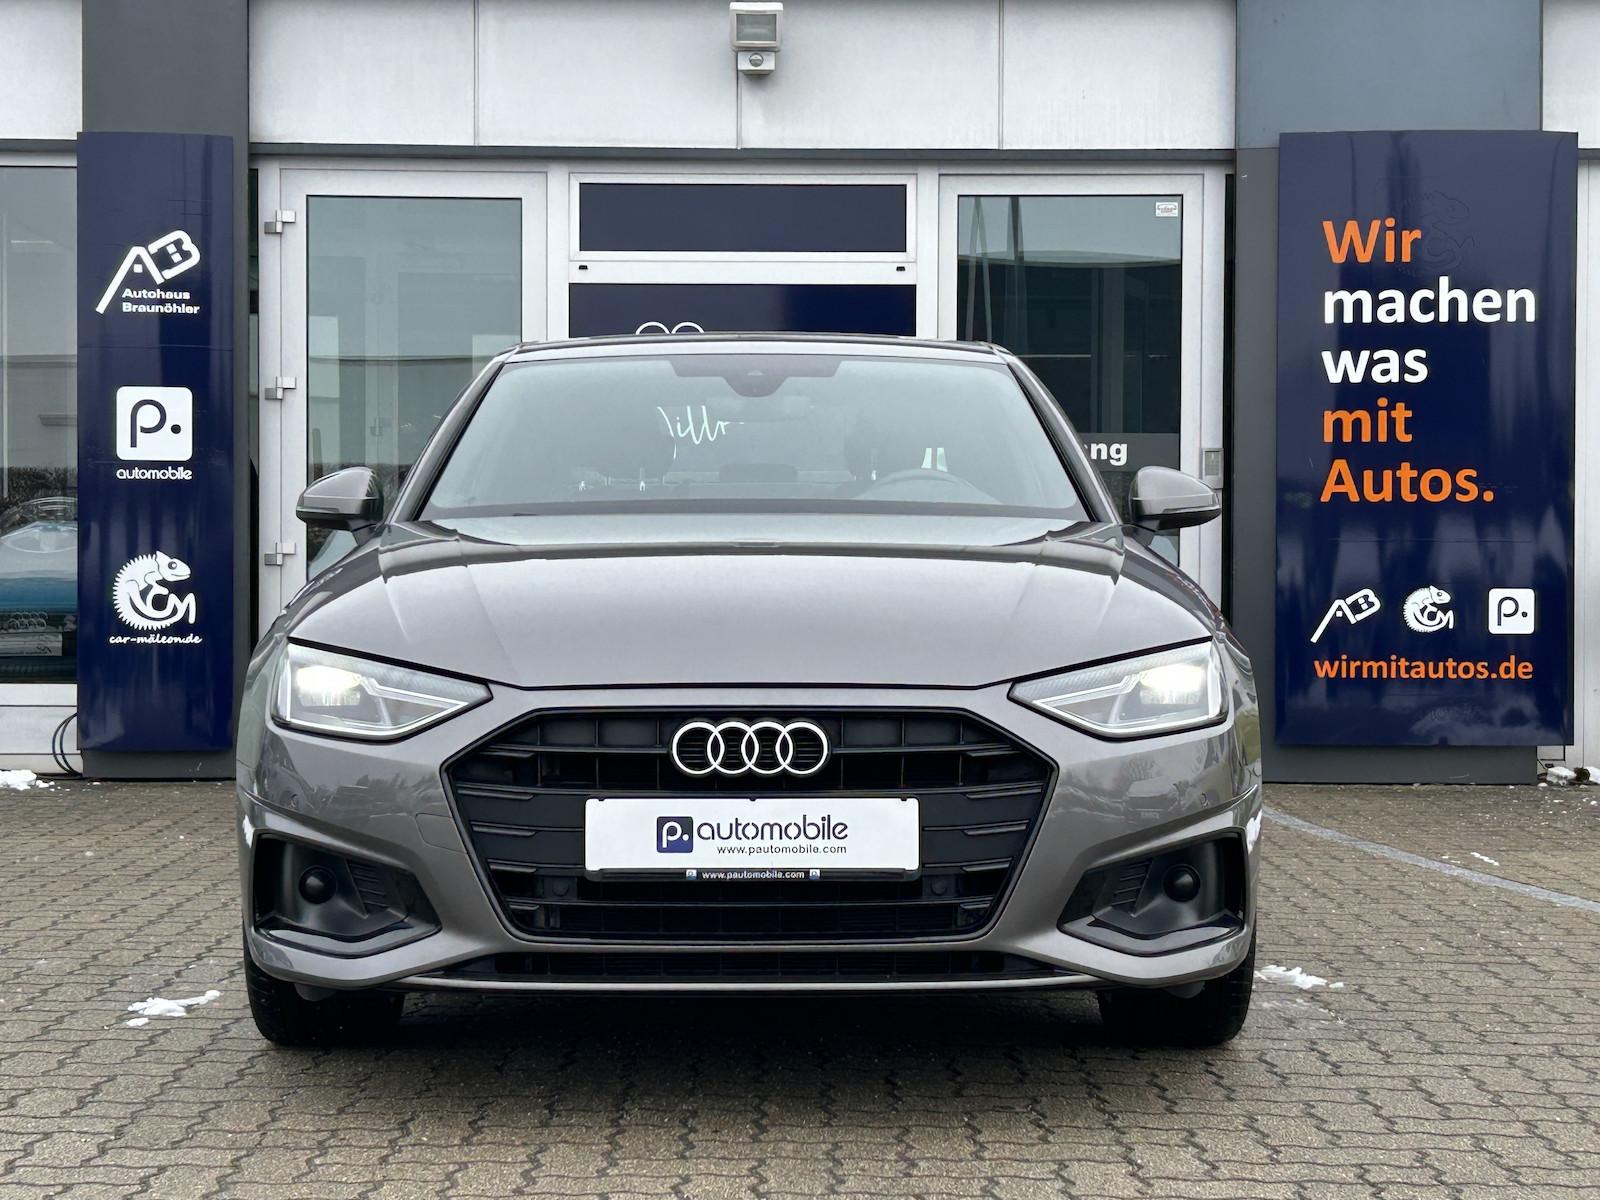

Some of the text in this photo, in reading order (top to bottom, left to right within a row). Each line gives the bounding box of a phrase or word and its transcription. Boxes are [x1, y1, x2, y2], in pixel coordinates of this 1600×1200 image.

[1321, 217, 1422, 264] Wir
[121, 288, 191, 300] Autohaus
[1323, 275, 1536, 324] machen
[121, 301, 201, 314] Braunöhler
[1321, 348, 1429, 384] was
[1323, 397, 1413, 443] mit
[1084, 442, 1128, 466] ng
[116, 466, 193, 480] automobile
[1320, 458, 1495, 504] Autos.
[109, 632, 203, 644] car-mäleon.de
[1313, 655, 1534, 680] wirmitautos.de
[696, 814, 849, 841] automobile
[717, 844, 847, 856] www.pautomobile.com
[701, 869, 805, 880] www.pautomobile.com
